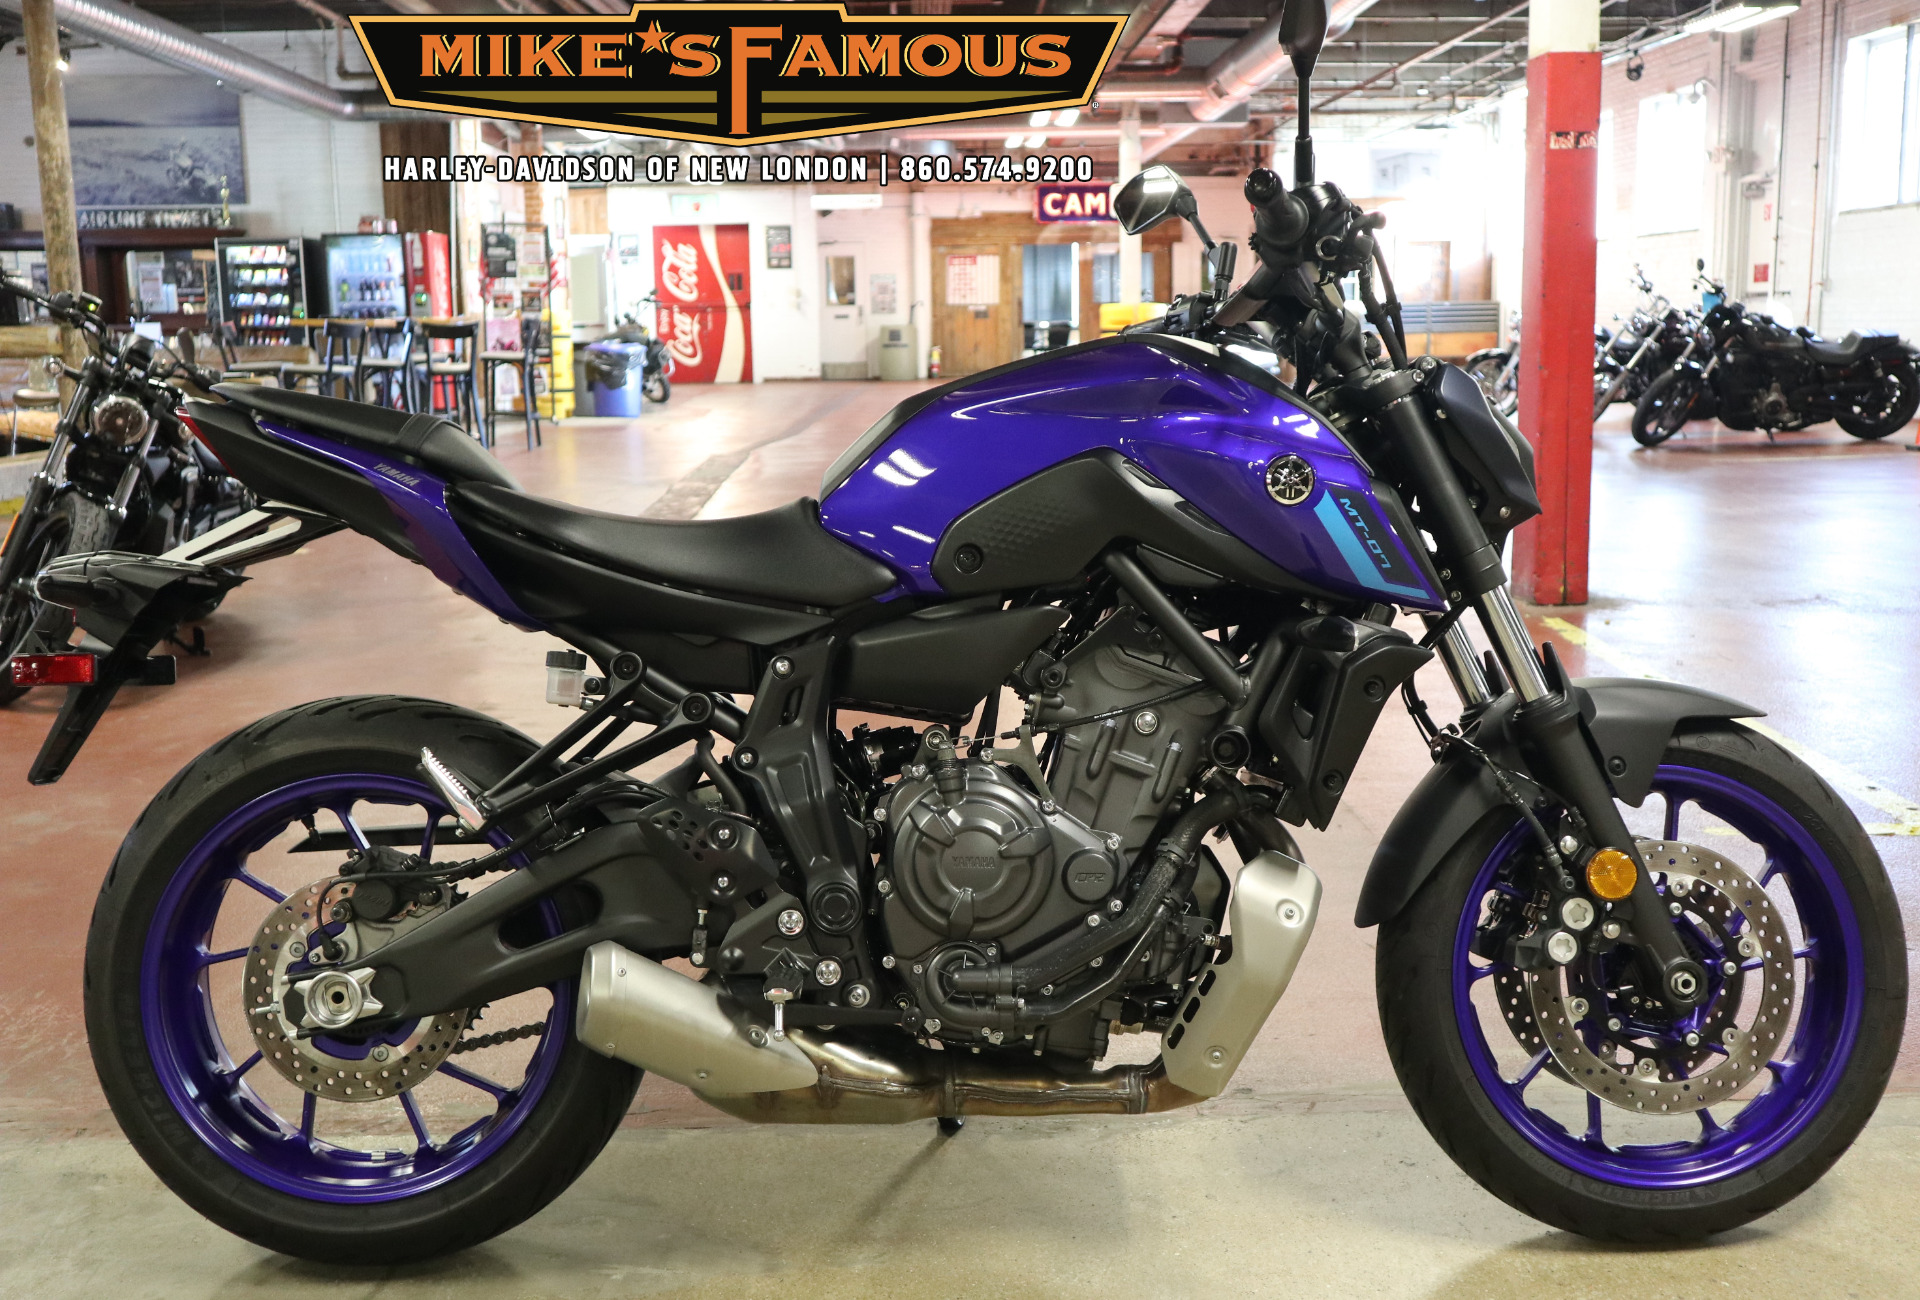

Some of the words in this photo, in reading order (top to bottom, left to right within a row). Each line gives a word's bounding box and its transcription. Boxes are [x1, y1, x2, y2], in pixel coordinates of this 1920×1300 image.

[373, 462, 420, 487] YAMAHA
[1339, 498, 1392, 568] MT-07
[951, 855, 996, 869] YAMAHA
[1588, 1182, 1691, 1203] MICHELIN
